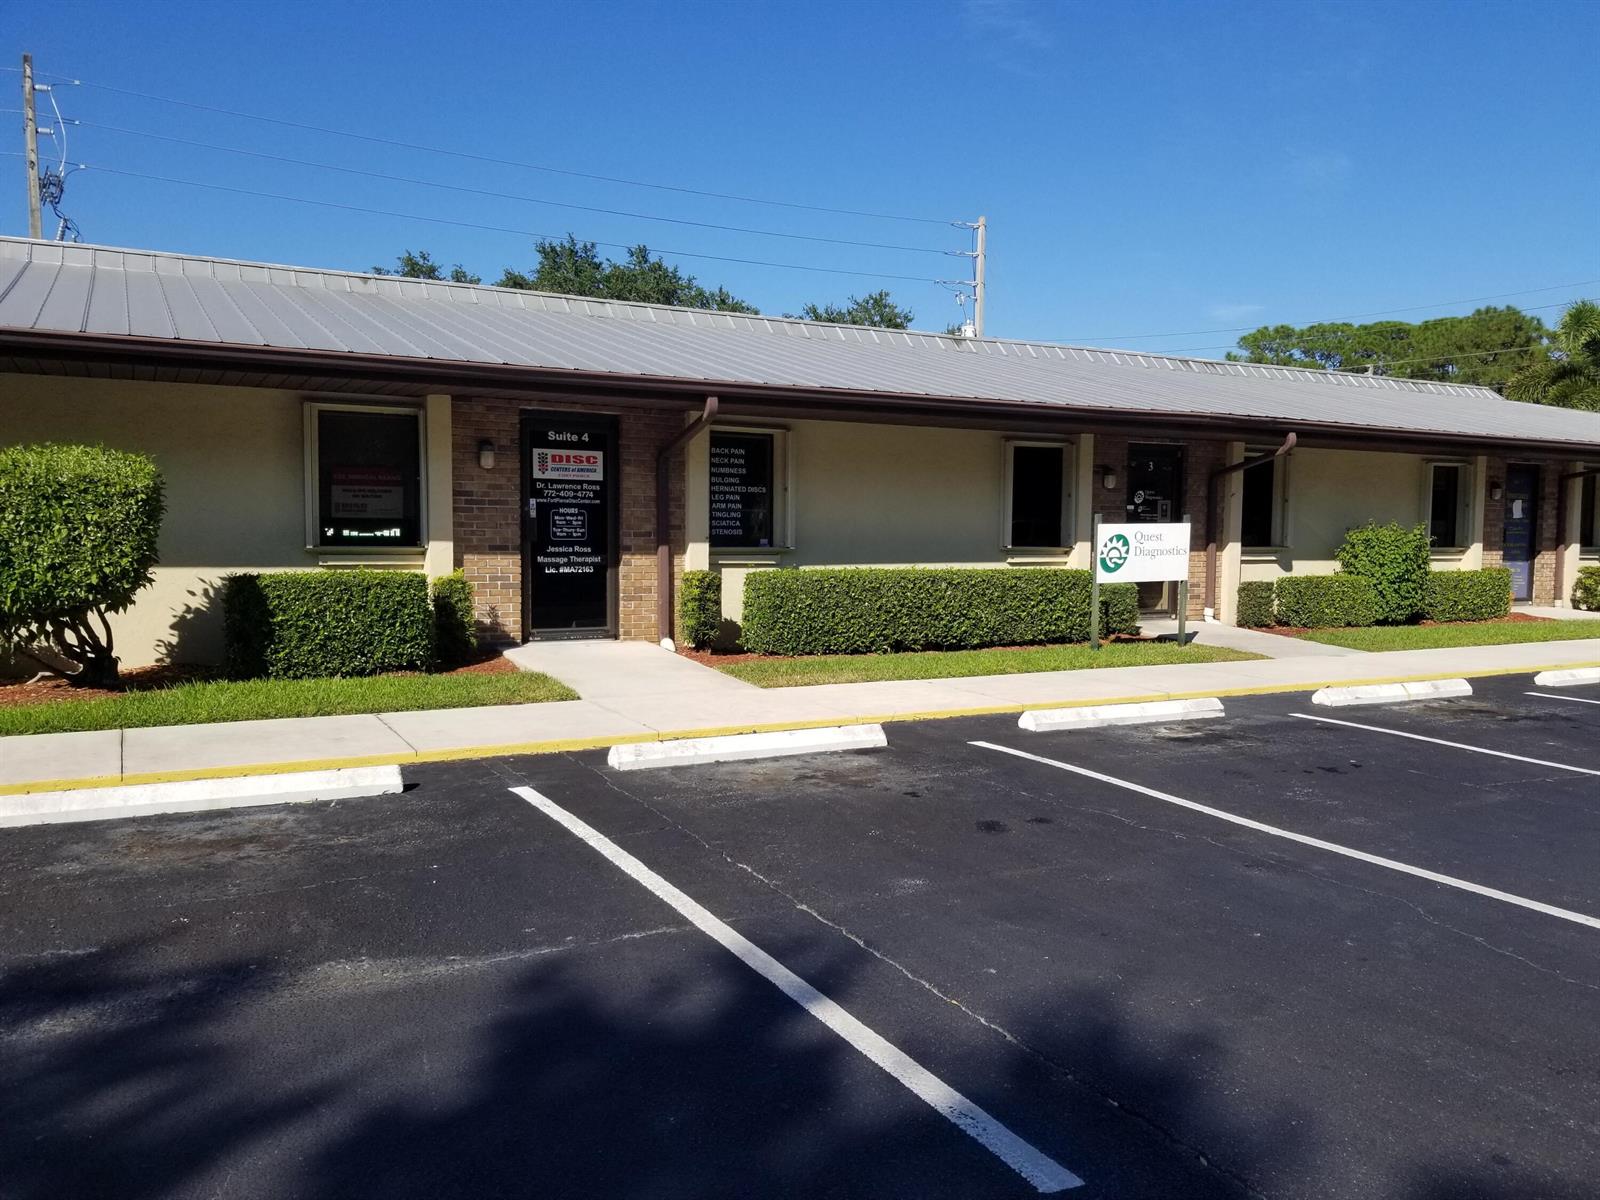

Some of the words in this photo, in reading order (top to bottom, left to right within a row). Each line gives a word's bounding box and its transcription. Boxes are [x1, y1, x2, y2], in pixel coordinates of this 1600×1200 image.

[548, 431, 579, 442] Suite
[581, 432, 590, 442] 4
[711, 447, 730, 455] BACK
[550, 454, 598, 464] DISC
[1148, 461, 1154, 472] 3
[711, 476, 740, 484] BULGING
[548, 482, 582, 490] Lawrence
[711, 485, 747, 493] HERNIATED
[543, 489, 594, 498] 772-409-4774
[711, 528, 743, 536] STENOSIS
[1134, 530, 1163, 545] Quest
[546, 545, 573, 553] Jessica
[574, 545, 592, 553] Ross
[1134, 545, 1188, 560] Diagnostics
[537, 555, 568, 564] Massage
[569, 555, 601, 564] Therapist
